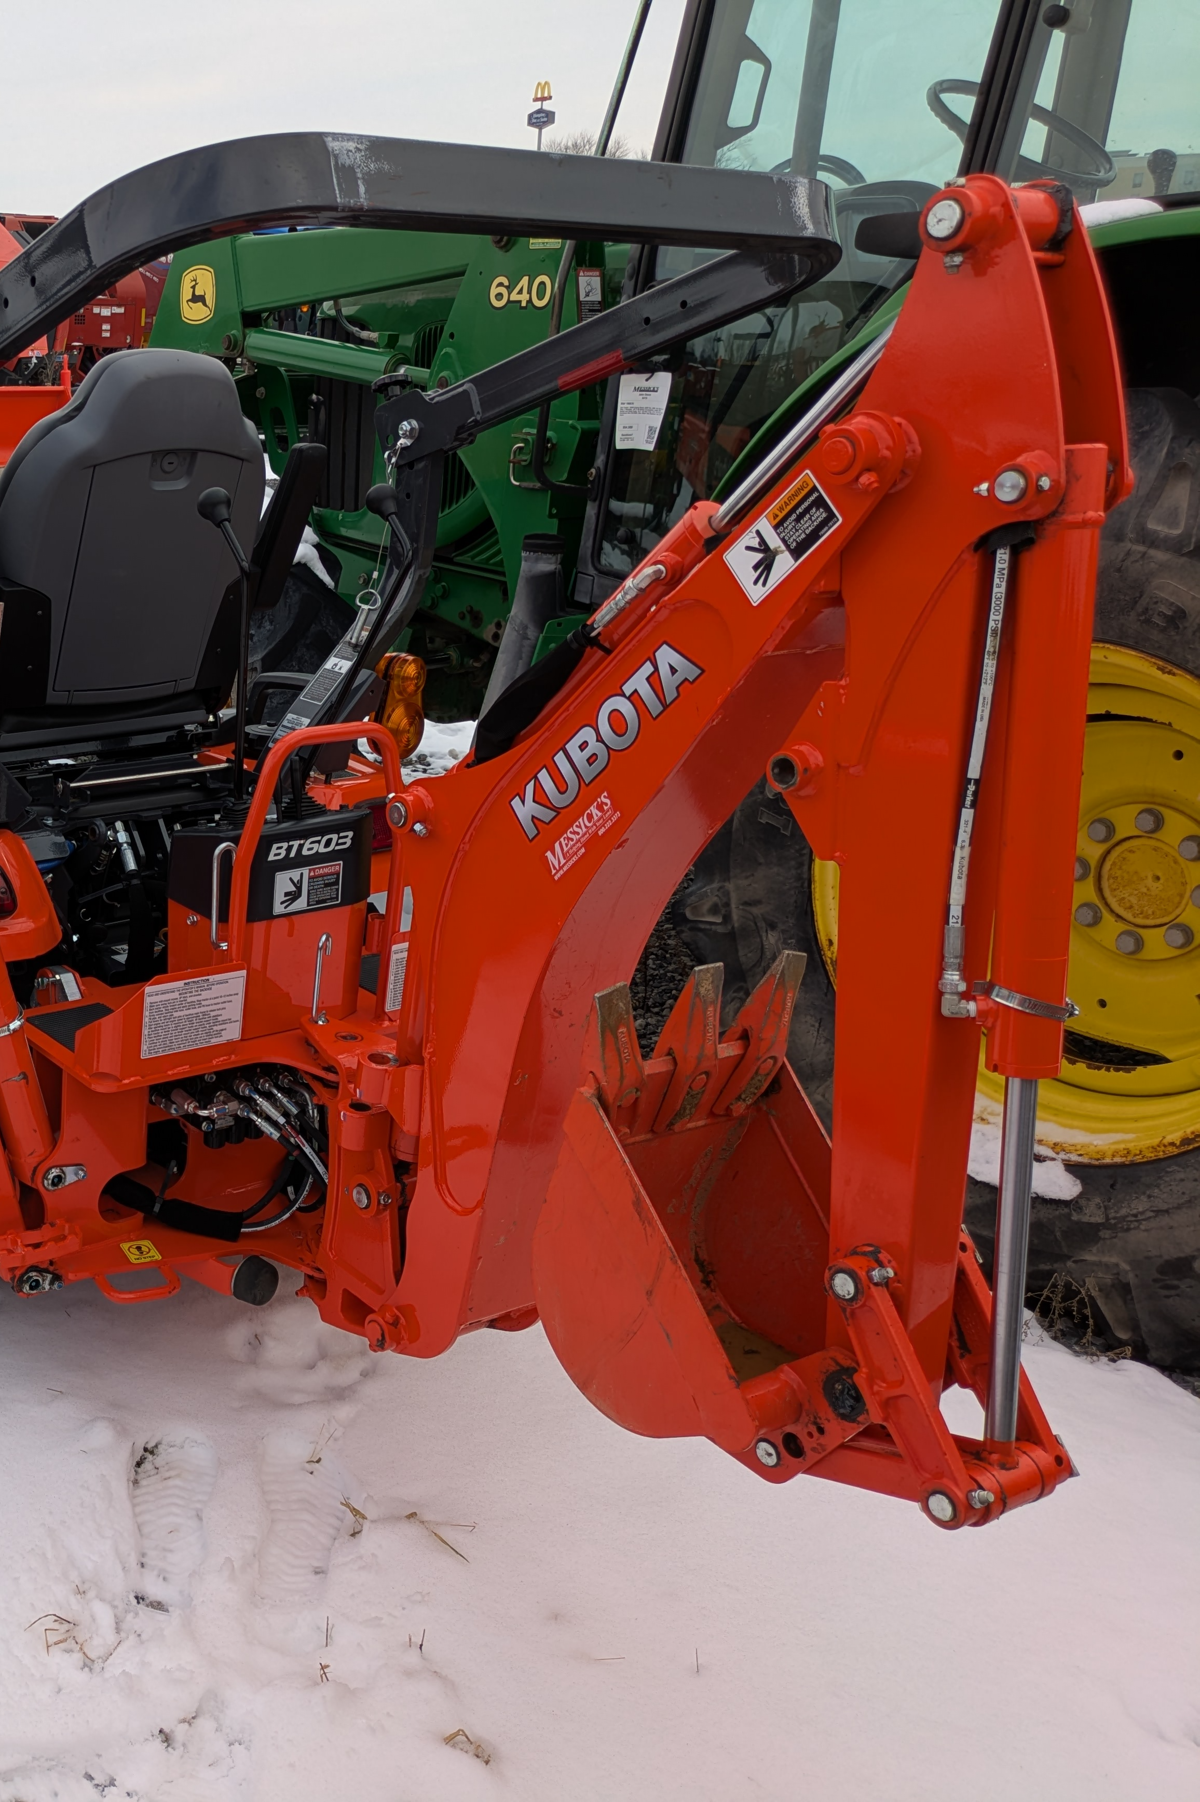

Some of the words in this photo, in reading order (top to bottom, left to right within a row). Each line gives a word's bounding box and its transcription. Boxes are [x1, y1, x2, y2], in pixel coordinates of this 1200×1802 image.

[489, 274, 552, 309] 640
[776, 526, 784, 534] TO
[783, 513, 797, 528] AVOID
[796, 491, 819, 515] PERSONAL
[777, 480, 810, 514] WARNING
[784, 528, 796, 541] STAY
[795, 513, 810, 530] CLEAR
[810, 507, 817, 515] OF
[787, 520, 812, 545] OPERATING
[811, 508, 824, 521] AREA
[790, 541, 797, 550] OF
[797, 533, 806, 543] THE
[995, 567, 1007, 589] MPa
[992, 591, 1004, 616] (3000
[509, 640, 706, 843] KUBOTA
[964, 781, 976, 809] Parker
[267, 831, 354, 861] BT603
[545, 791, 611, 875] MESSICK'S
[314, 865, 340, 875] DANGER
[957, 856, 966, 880] Kubota
[183, 978, 210, 986] INSTRUCTION
[706, 1006, 715, 1045] KUBOTA
[618, 1027, 631, 1063] KUBOTA
